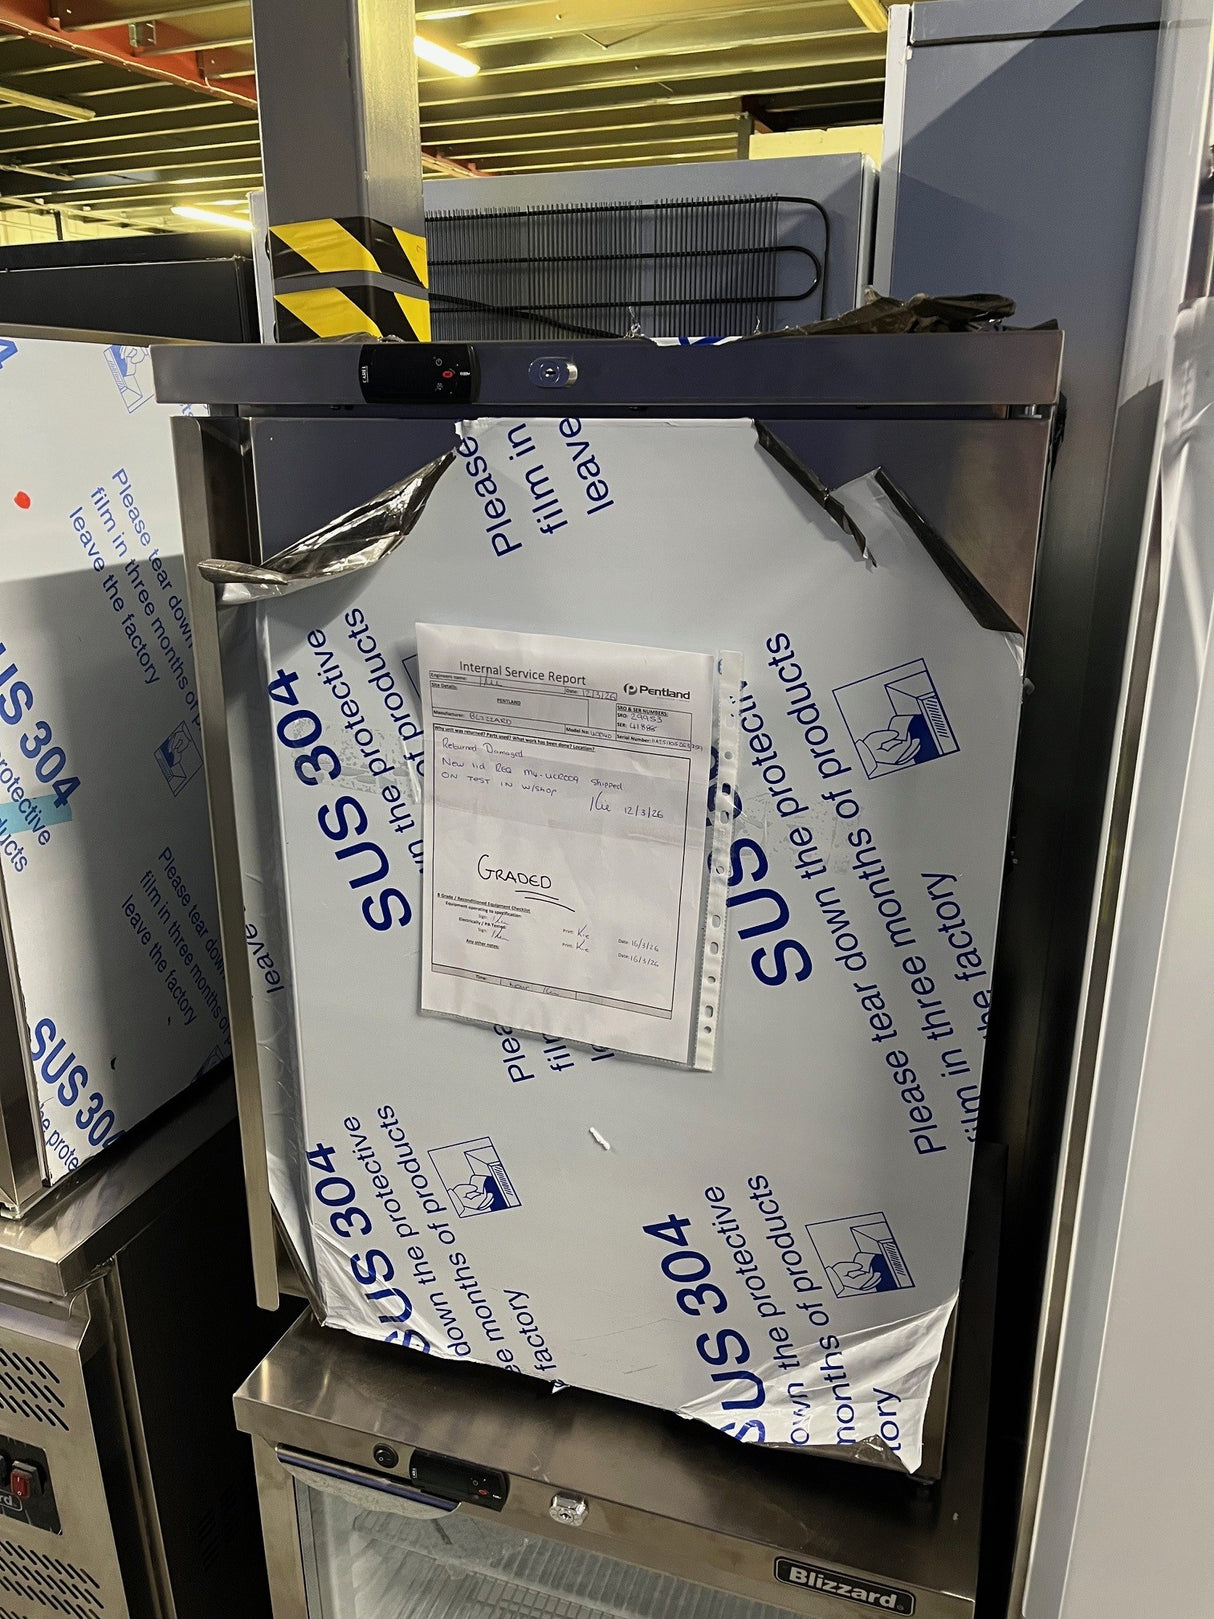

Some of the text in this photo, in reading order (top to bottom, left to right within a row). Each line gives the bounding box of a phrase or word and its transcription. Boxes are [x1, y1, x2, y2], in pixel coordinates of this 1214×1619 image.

[456, 436, 523, 557] Please
[507, 422, 568, 534] film in
[558, 417, 614, 515] leave
[111, 467, 151, 547] Please
[147, 547, 173, 592] tear
[69, 506, 161, 685] leave the factory
[90, 486, 117, 532] film
[112, 532, 128, 558] in
[124, 558, 155, 617] three
[151, 616, 189, 690] months
[344, 608, 424, 741] products
[460, 661, 502, 676] Internal
[504, 666, 545, 682] Service
[549, 671, 586, 686] Report
[639, 685, 690, 700] Pentland
[766, 632, 852, 779] products
[19, 720, 81, 809] 304
[307, 629, 415, 833] the protective
[441, 757, 465, 769] New
[441, 771, 458, 780] ON
[442, 737, 523, 758] Returned Damaged
[268, 669, 413, 931] SUS 304
[623, 805, 664, 820] 12/3/26
[821, 788, 860, 819] of
[159, 847, 191, 906] Please
[188, 903, 210, 940] tear
[477, 853, 552, 890] GRADED
[789, 826, 827, 880] the
[848, 828, 916, 948] months
[121, 895, 197, 1026] leave the factory
[139, 869, 162, 907] film
[157, 902, 171, 925] in
[168, 919, 193, 967] three
[190, 963, 222, 1019] months
[245, 923, 284, 994] leave
[631, 937, 660, 952] 16/3/26
[814, 886, 867, 971] down
[921, 872, 987, 982] factory
[853, 982, 898, 1043] tear
[902, 955, 954, 1041] three
[32, 1017, 89, 1107] SUS
[885, 1050, 947, 1155] Please
[940, 1048, 971, 1078] in
[307, 1142, 372, 1238] 304
[343, 1116, 471, 1357] down the protective
[377, 1105, 505, 1343] months of products
[747, 1174, 823, 1293] products
[642, 1213, 728, 1316] 304
[704, 1186, 786, 1318] protective
[503, 1288, 557, 1372] factory
[768, 1326, 801, 1370] the
[796, 1302, 830, 1326] of
[789, 1566, 897, 1609] Blizzard
